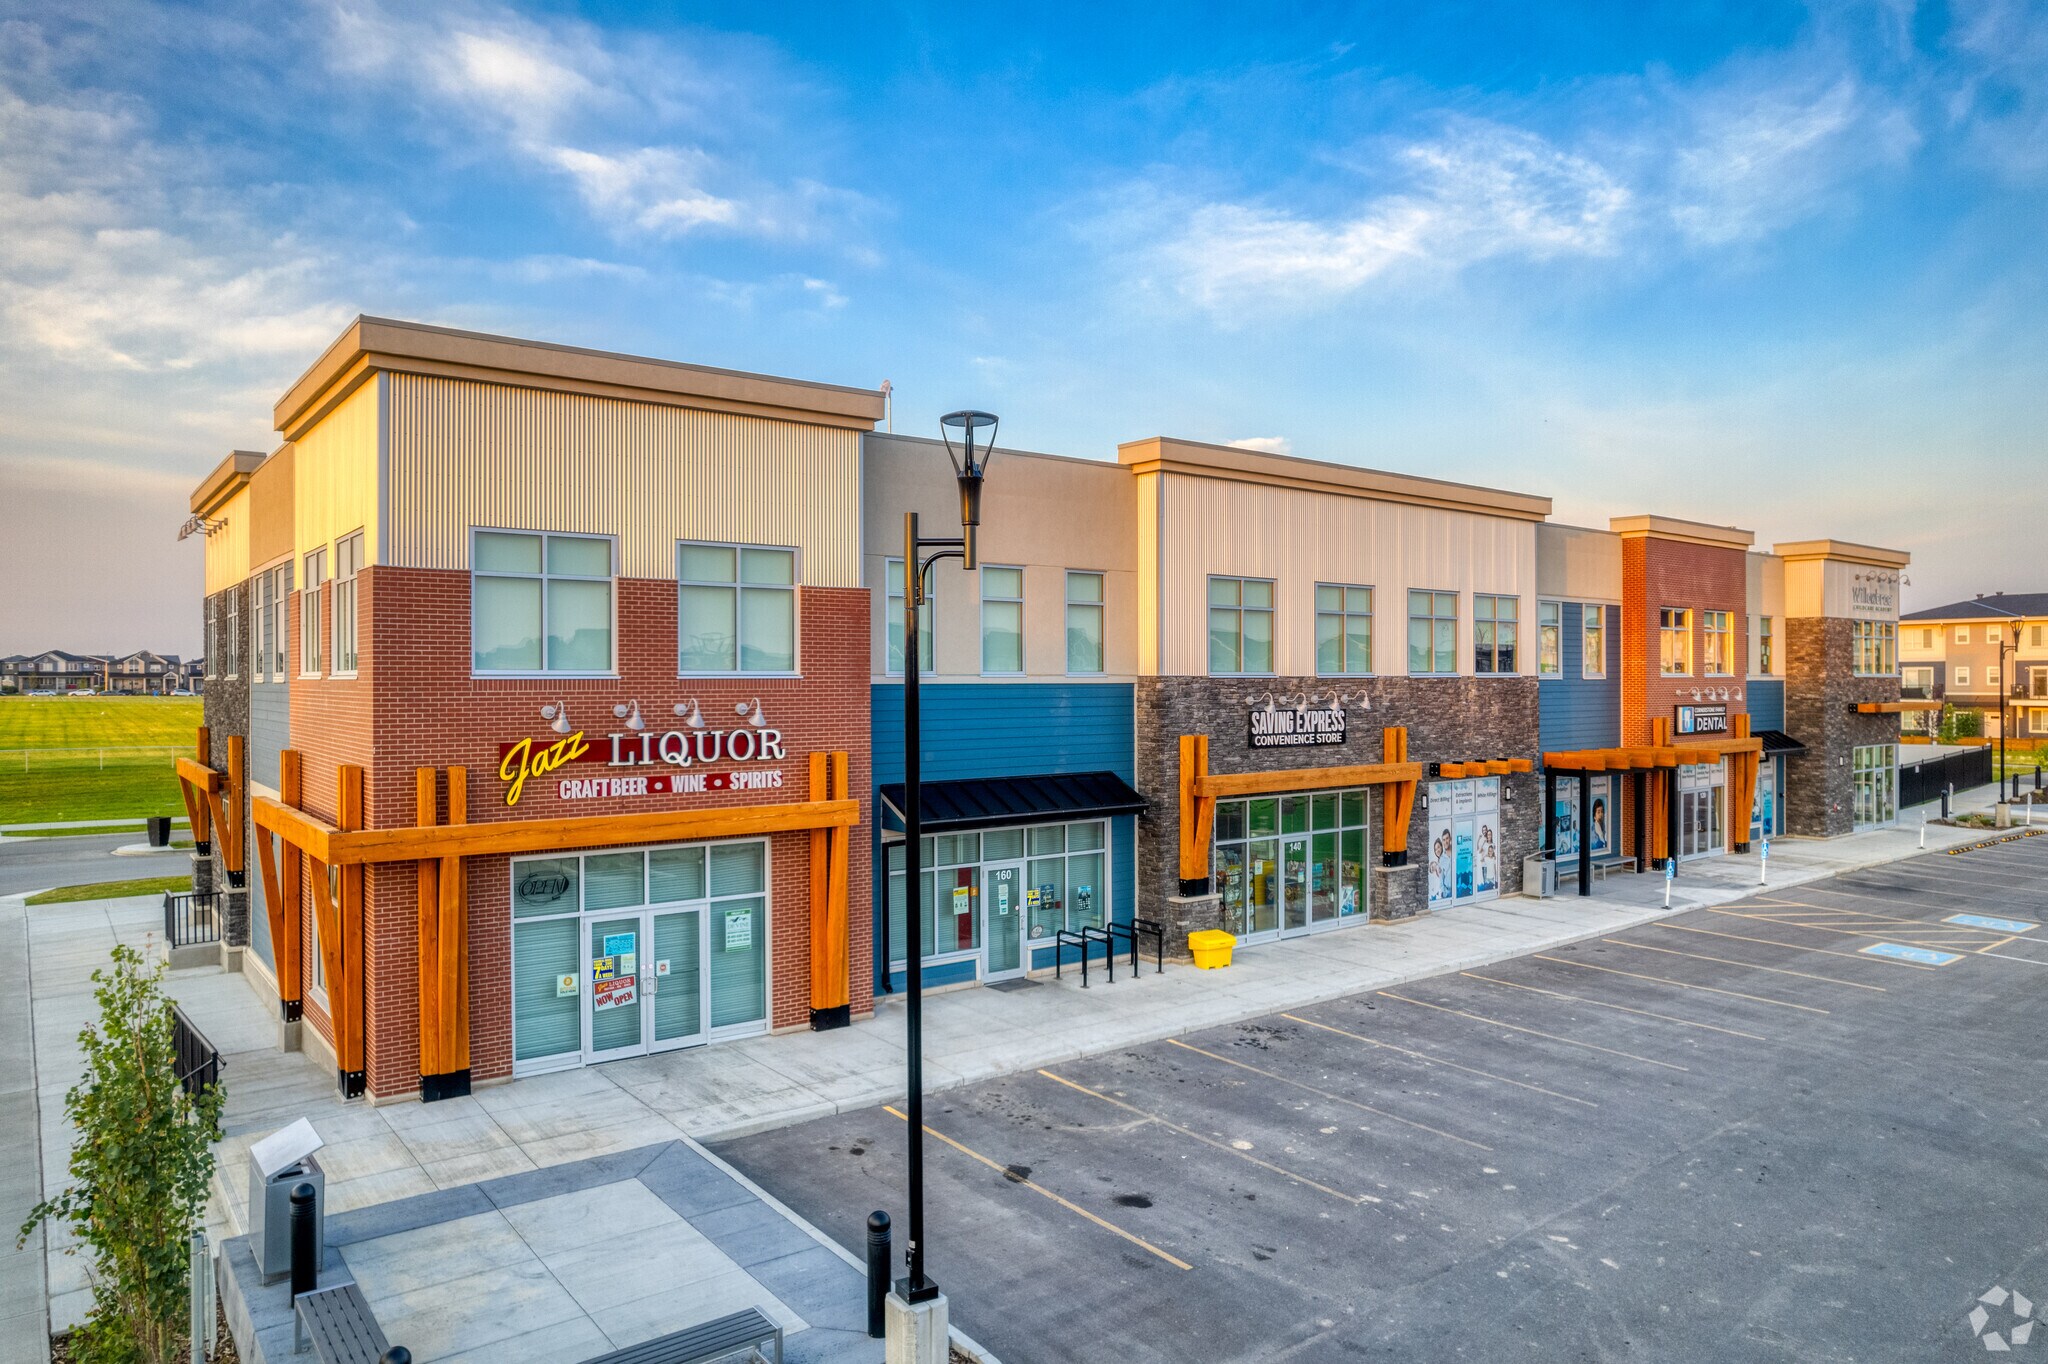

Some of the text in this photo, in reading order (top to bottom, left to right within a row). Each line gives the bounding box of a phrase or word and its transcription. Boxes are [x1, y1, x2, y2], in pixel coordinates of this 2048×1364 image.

[1251, 710, 1345, 735] SAVING EXPRESS
[1696, 716, 1728, 731] DENTAL
[1254, 733, 1343, 746] CONVENIENCE STORE
[499, 728, 786, 806] Jazz LIQUOR
[670, 774, 708, 793] WINE
[729, 770, 783, 791] SPIRITS
[1289, 842, 1301, 852] 140
[995, 870, 1012, 880] 160
[594, 966, 601, 980] 7
[596, 990, 633, 1007] NOW OPEN
